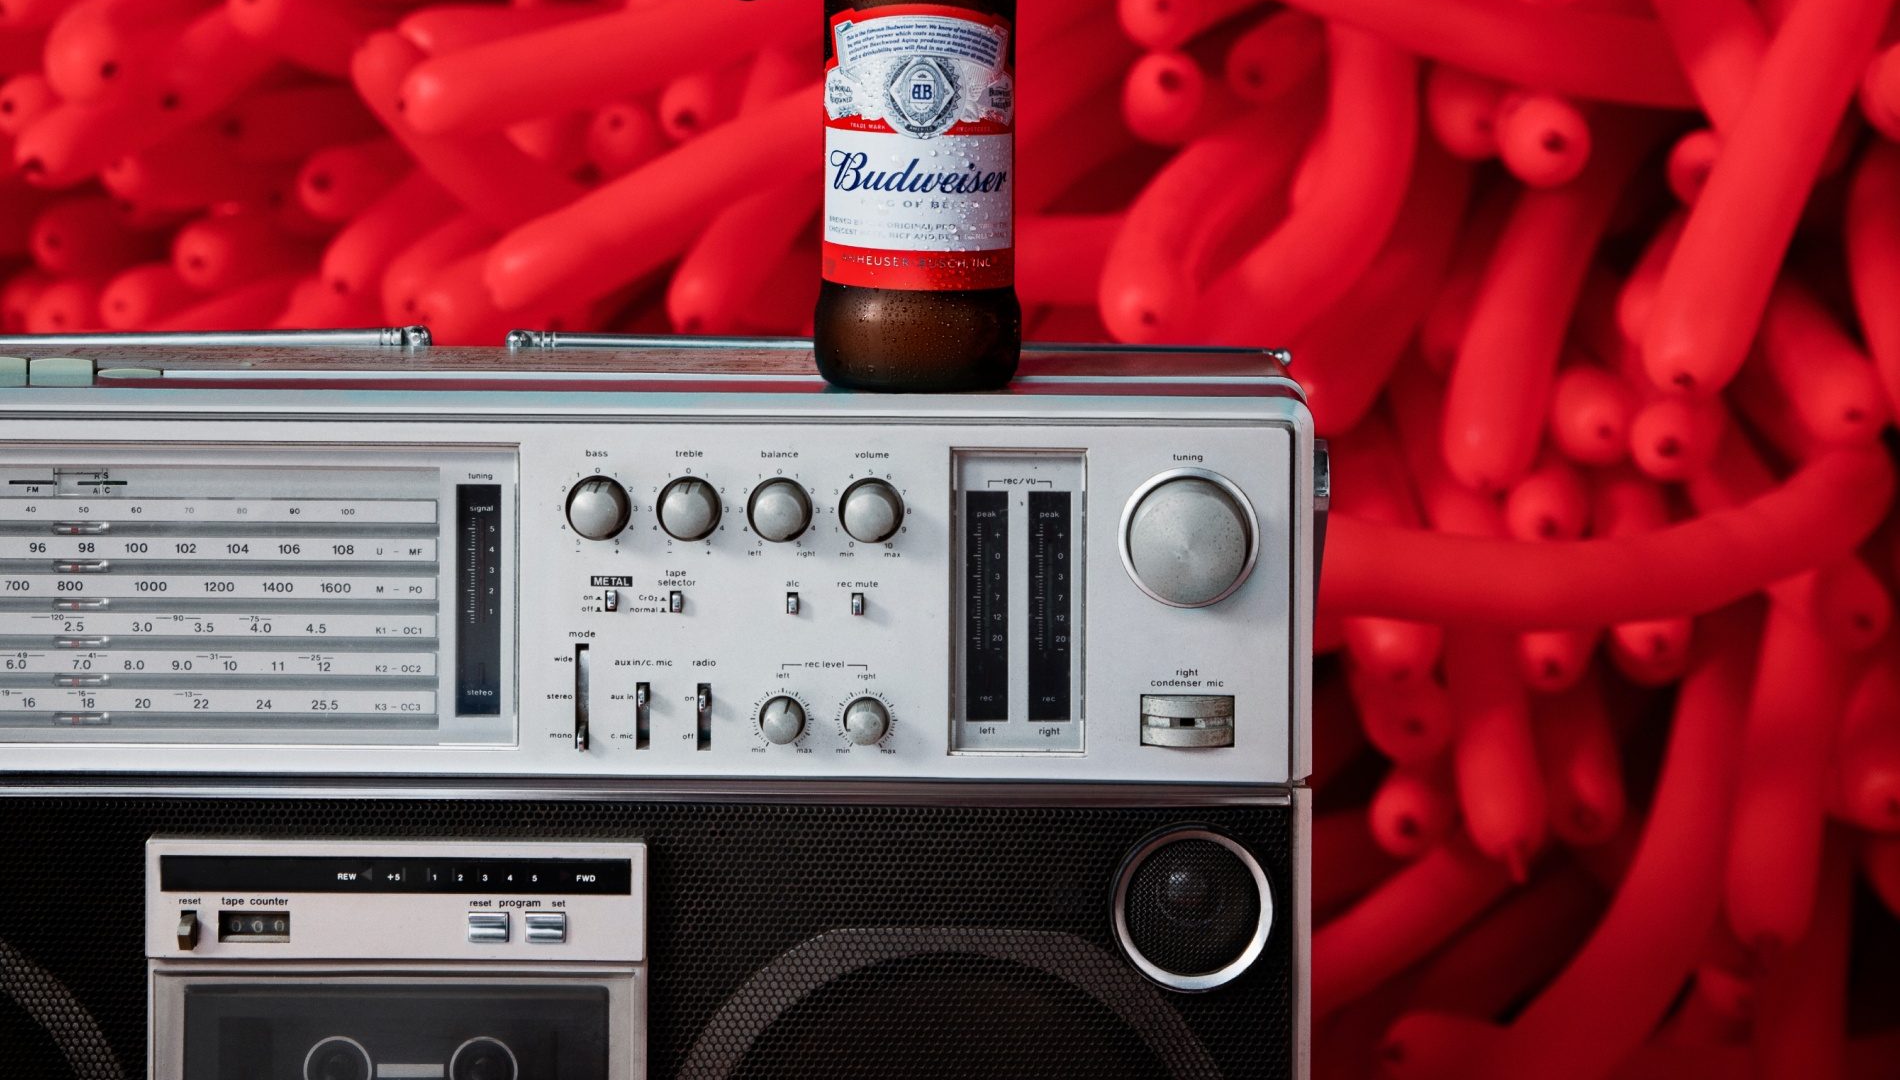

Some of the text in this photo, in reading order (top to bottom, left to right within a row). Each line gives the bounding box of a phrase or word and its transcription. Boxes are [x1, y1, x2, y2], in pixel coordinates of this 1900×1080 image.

[830, 149, 1007, 194] Budweiser
[585, 450, 609, 458] bass
[675, 450, 704, 458] treble
[761, 450, 799, 459] balance
[855, 451, 890, 459] volume
[1173, 453, 1204, 463] tuning
[468, 472, 494, 481] tuning
[131, 506, 142, 514] 60
[237, 507, 248, 515] 80
[489, 525, 495, 533] 5
[29, 542, 423, 556] 96 98 100 102 104 106 108 U MF
[748, 549, 762, 557] left
[797, 550, 816, 559] right
[489, 566, 495, 574] 3
[665, 569, 687, 578] tape
[593, 577, 630, 587] METAL
[657, 578, 696, 587] selector
[786, 580, 800, 588] alc
[837, 580, 879, 588] rec mute
[5, 580, 423, 594] 700 800 1000 1200 1400 1600 M PO
[489, 587, 494, 595] 2
[64, 621, 423, 635] 2.5 3.0 3.5 4.0 4.5 K1 OC1
[568, 630, 596, 638] mode
[554, 655, 573, 663] wide
[656, 659, 673, 667] mic
[692, 659, 717, 667] radio
[6, 659, 422, 673] 6.0 7.0 8.0 9.0 10 11 12 K2 OC2
[1176, 668, 1199, 678] right
[1150, 677, 1224, 688] condenser mic
[466, 688, 493, 697] stereo
[22, 697, 421, 712] 16 18 20 22 24 25.5 K3 OC3
[979, 727, 996, 735] left
[1039, 727, 1060, 737] right
[337, 873, 357, 881] REW
[458, 874, 464, 882] 2
[507, 874, 513, 882] 4
[576, 875, 596, 883] FWD
[179, 897, 201, 905] reset
[221, 897, 289, 907] tape counter
[469, 899, 566, 909] reset program set
